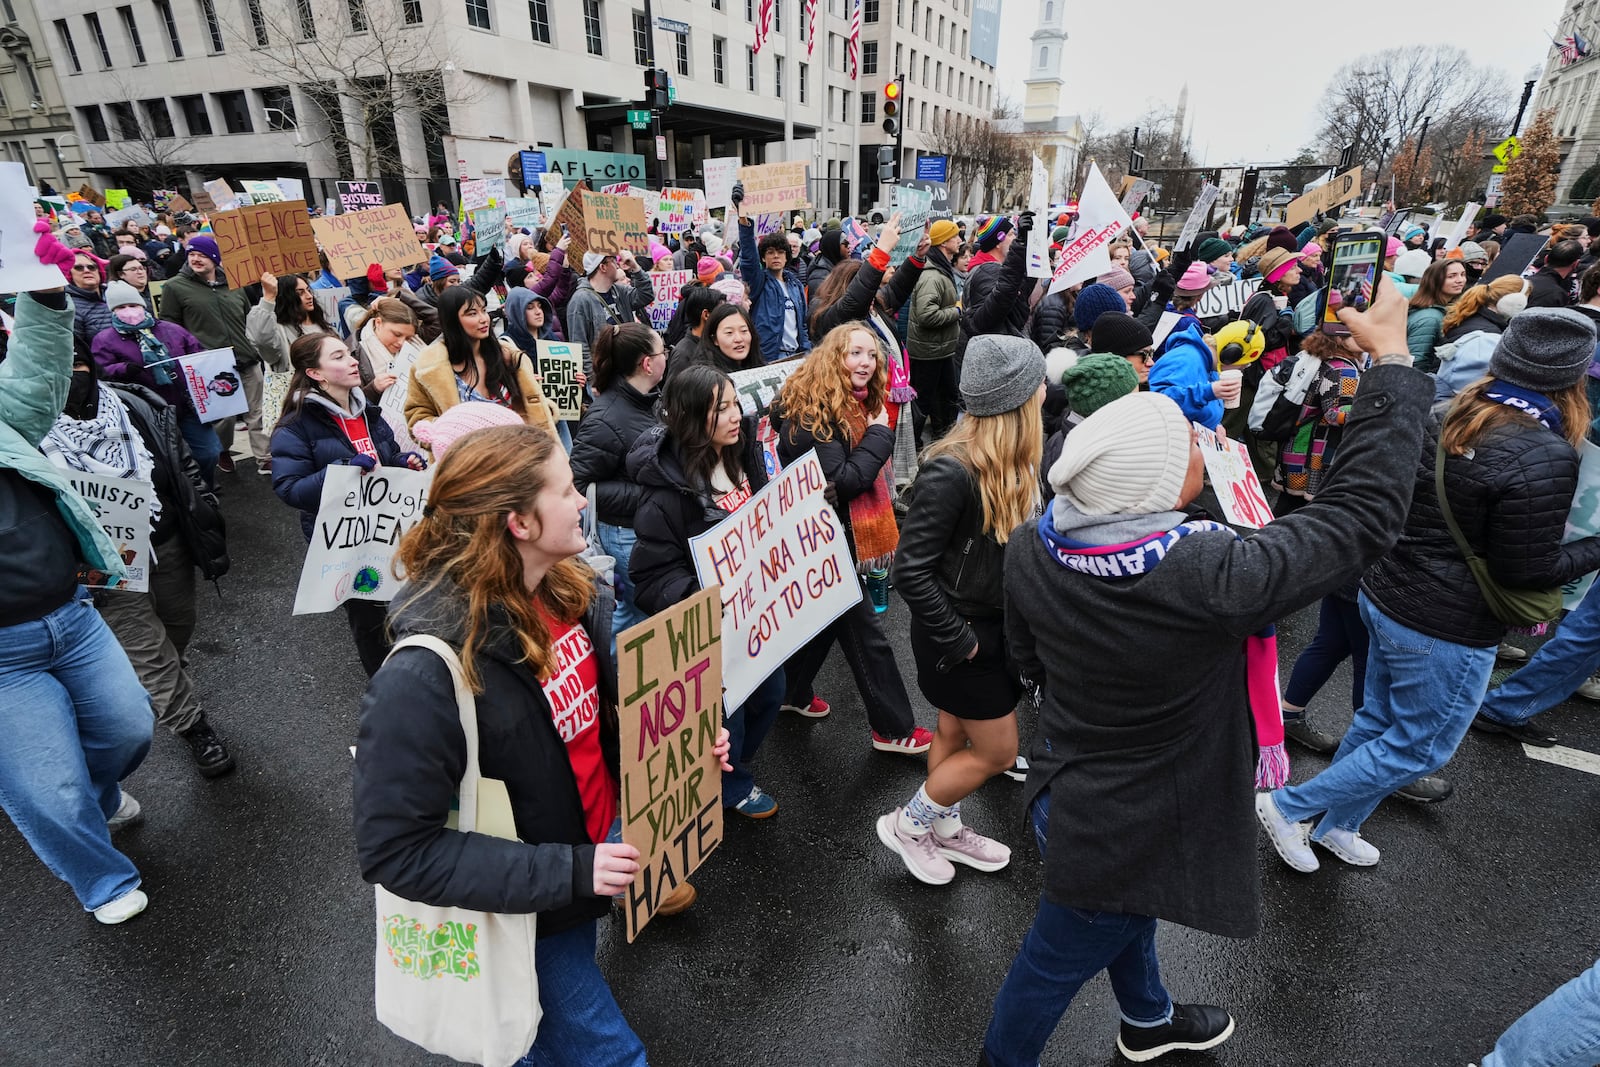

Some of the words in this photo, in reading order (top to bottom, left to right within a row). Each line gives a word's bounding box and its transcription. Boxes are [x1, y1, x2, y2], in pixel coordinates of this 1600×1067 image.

[551, 160, 640, 179] AFL-CIO
[348, 183, 368, 193] MY
[660, 188, 668, 200] A
[778, 187, 808, 202] STATE
[583, 194, 619, 209] THERE'S
[324, 216, 352, 232] YOU
[358, 208, 398, 225] BUILD
[596, 208, 620, 221] MORE
[613, 221, 639, 231] THAN
[669, 213, 685, 222] OWN
[213, 208, 311, 254] SILENCE
[346, 229, 354, 239] A
[588, 227, 619, 255] CIS
[326, 241, 367, 259] WE'LL
[343, 254, 367, 271] IT
[650, 271, 687, 287] TEACH
[658, 286, 679, 302] GIR
[1195, 278, 1263, 315] USTIC
[322, 513, 417, 550] VIOLEN
[708, 520, 749, 587] HEY
[748, 492, 773, 549] HEY,
[778, 476, 794, 517] HO
[796, 459, 823, 500] HO,
[724, 571, 757, 630] THE
[759, 538, 795, 592] NRA
[796, 508, 835, 557] HAS
[747, 600, 780, 658] GOT
[780, 580, 803, 618] TO
[806, 554, 842, 600] GO!
[624, 629, 659, 708] I
[666, 597, 721, 672] WILL
[550, 673, 581, 720] AND
[638, 657, 711, 762] NOT
[625, 702, 717, 826] LEARN
[647, 767, 704, 857] YOUR
[629, 795, 718, 934] HATE
